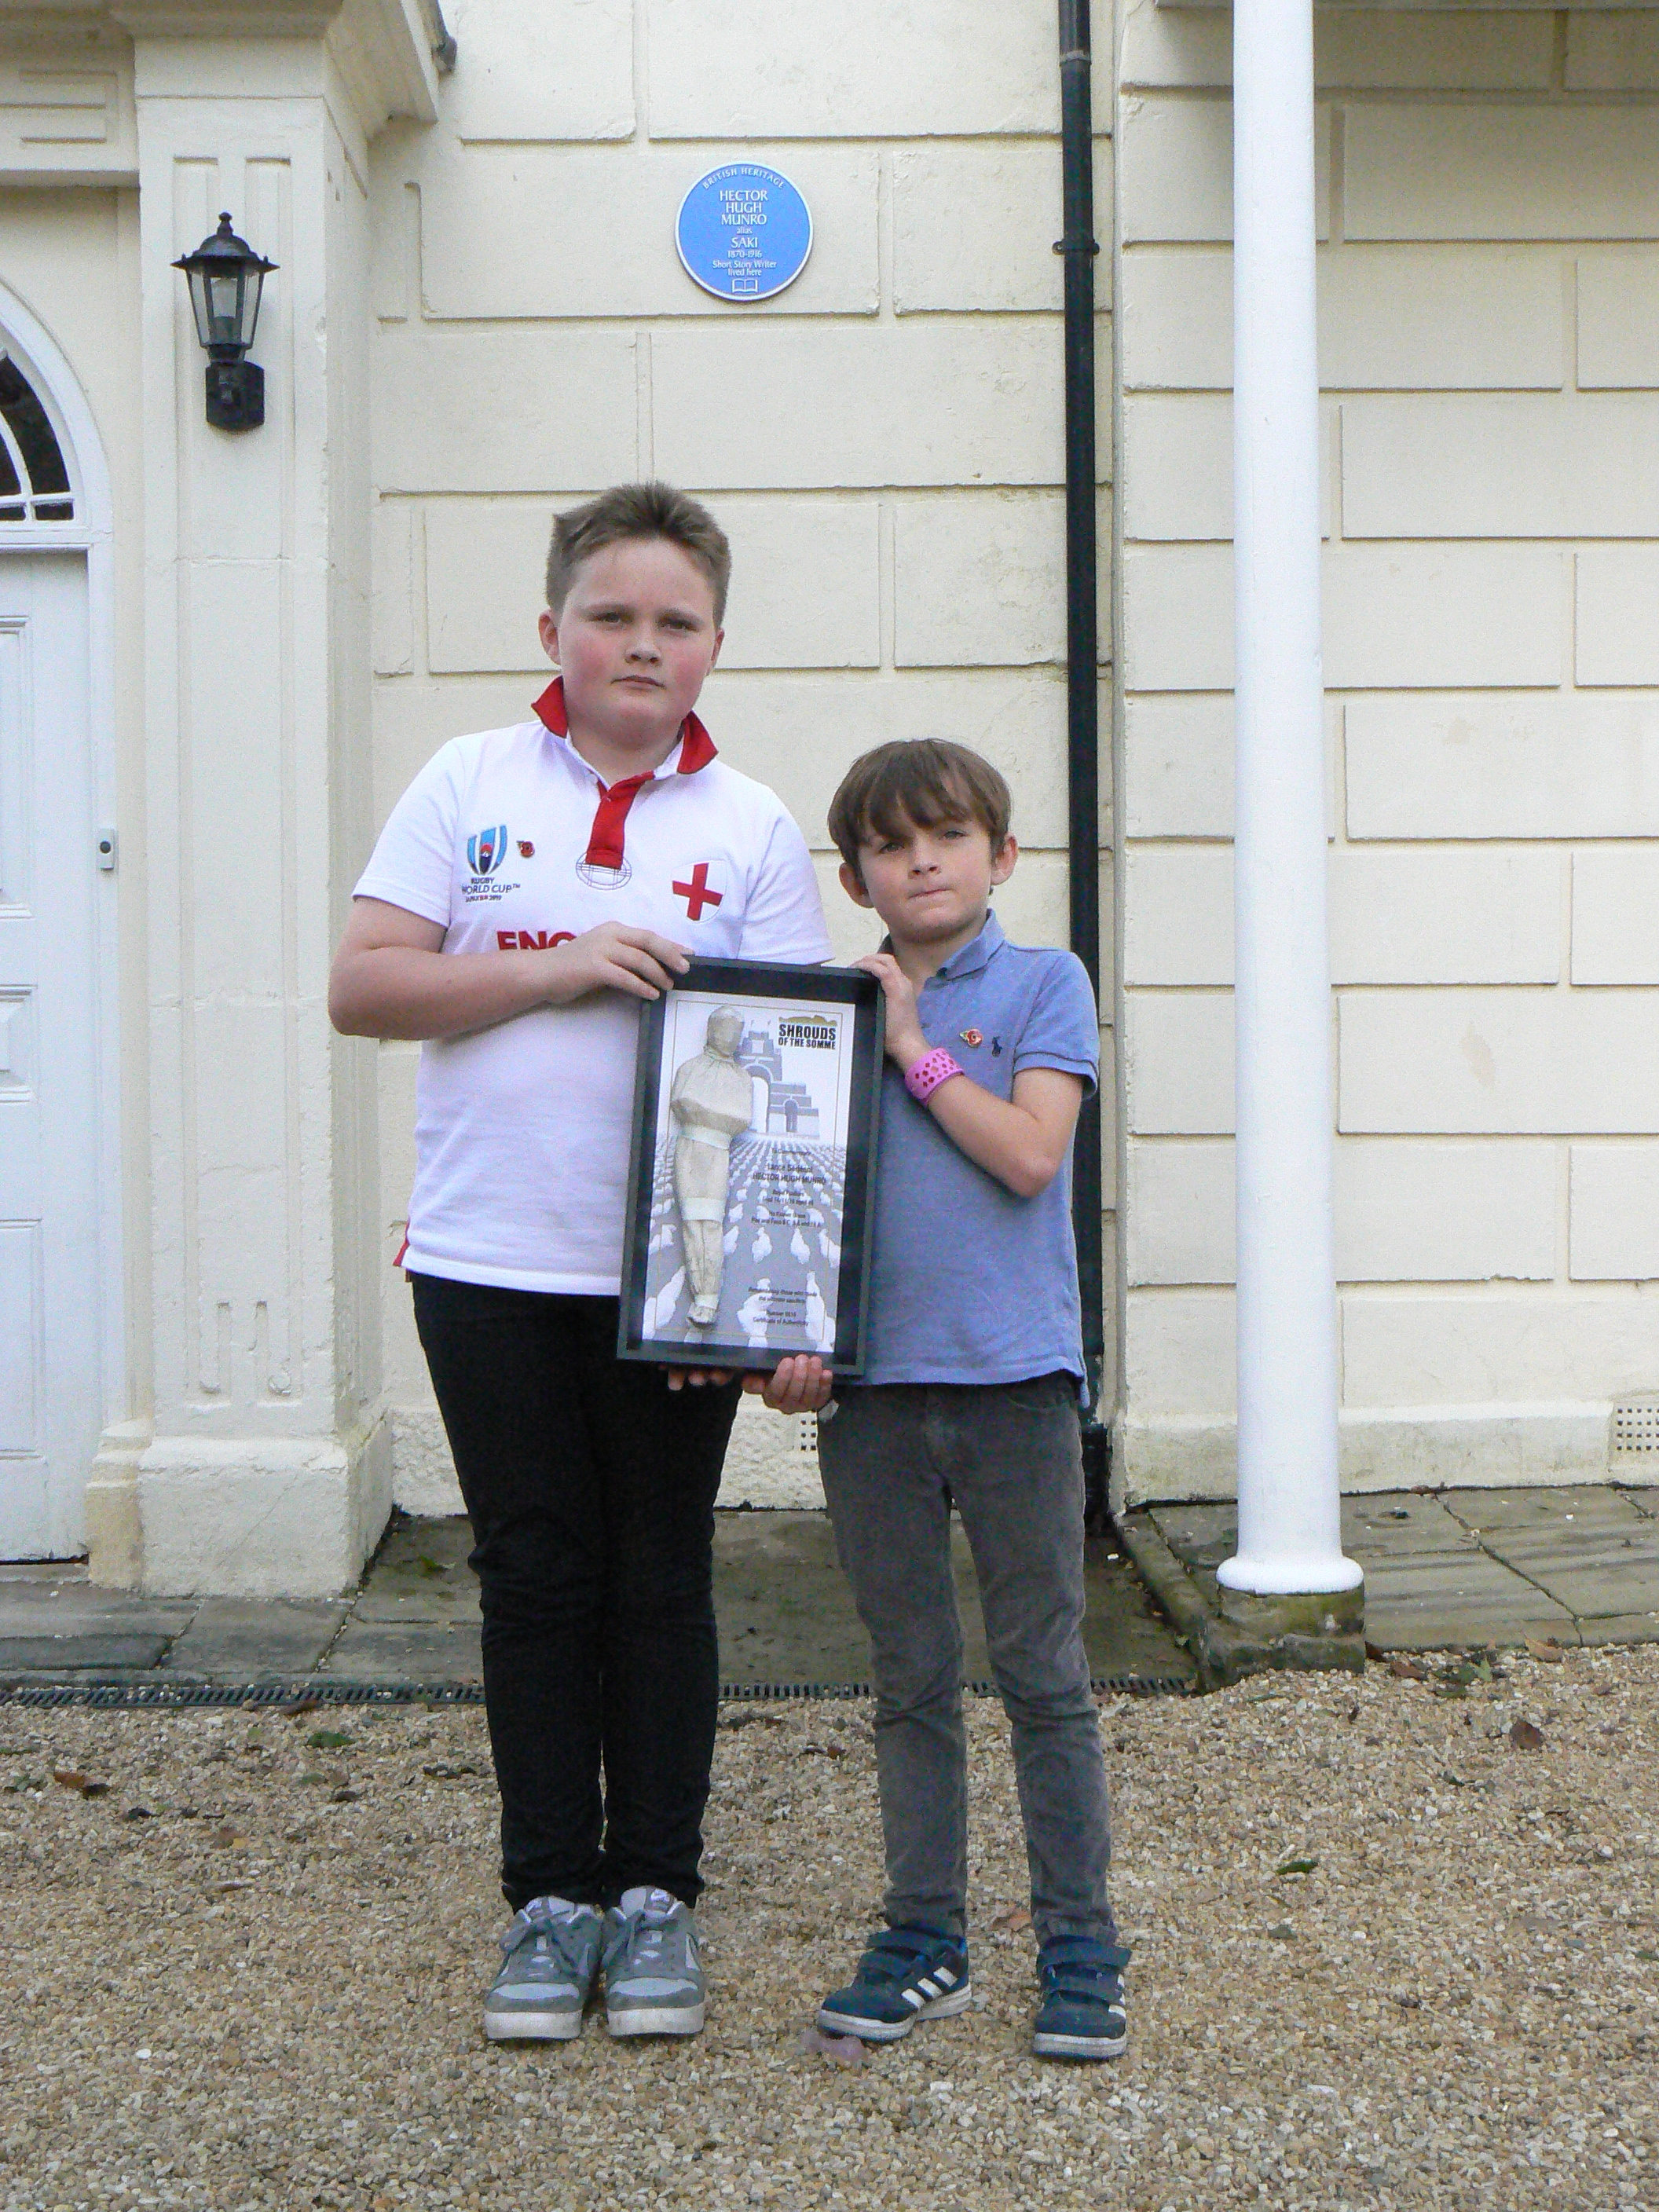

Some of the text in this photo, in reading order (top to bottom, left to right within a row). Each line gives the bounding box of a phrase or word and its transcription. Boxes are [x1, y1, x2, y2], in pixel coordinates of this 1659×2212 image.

[701, 167, 786, 190] BRITISH HERITAGE
[720, 189, 769, 201] HECTOR
[725, 202, 762, 214] HUGH
[721, 214, 767, 225] MUNRO
[736, 226, 753, 235] alias
[731, 236, 759, 249] SAKI
[712, 259, 778, 269] Short Story Writer
[727, 268, 762, 276] lived here
[461, 884, 490, 895] WORLD
[778, 1024, 837, 1041] SHROUDS
[778, 1037, 836, 1049] OF THE SOMME
[753, 1171, 826, 1185] HECTOR HUGH MUNRO
